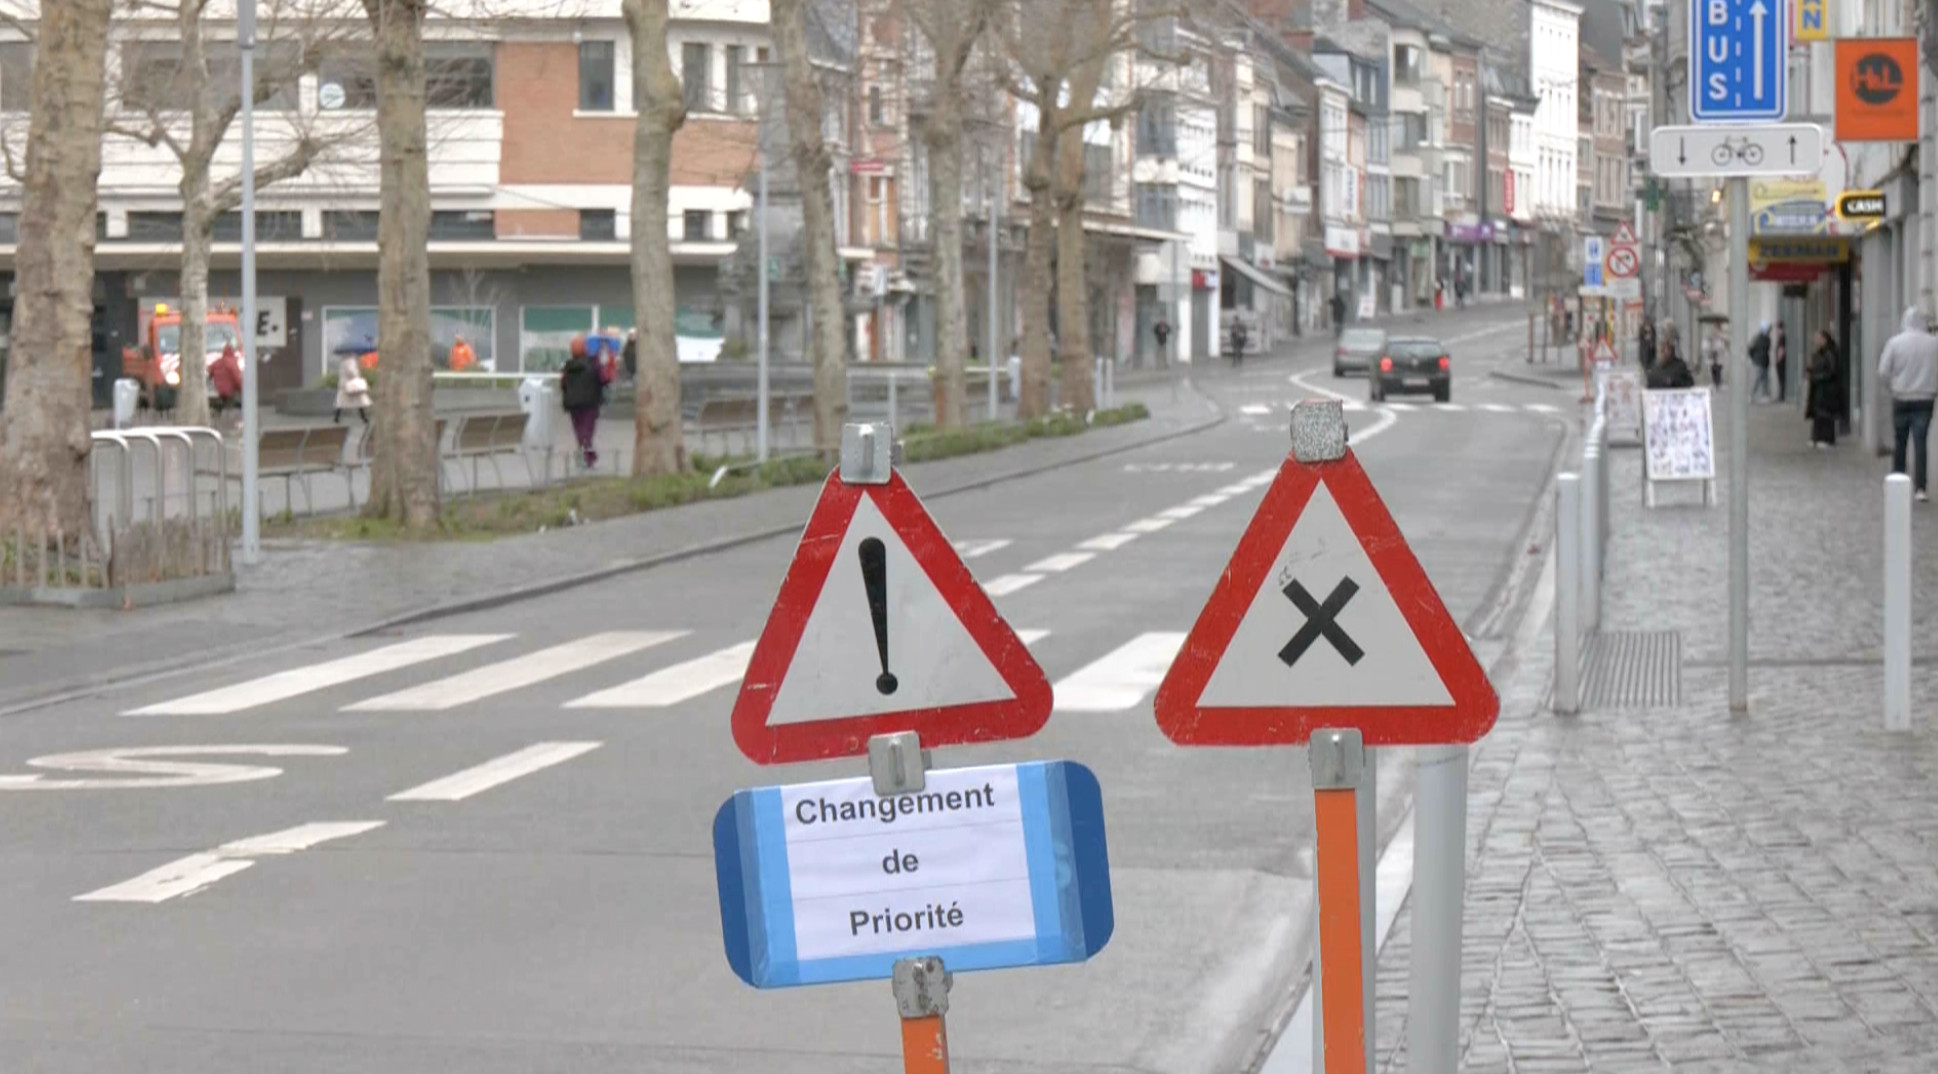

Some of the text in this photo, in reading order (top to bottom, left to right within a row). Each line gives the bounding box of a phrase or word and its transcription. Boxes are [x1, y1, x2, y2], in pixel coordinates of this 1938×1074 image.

[1708, 0, 1728, 101] BUS
[1846, 199, 1884, 214] CASH
[795, 783, 995, 824] Changement
[882, 848, 919, 875] de
[849, 901, 964, 936] Priorité
